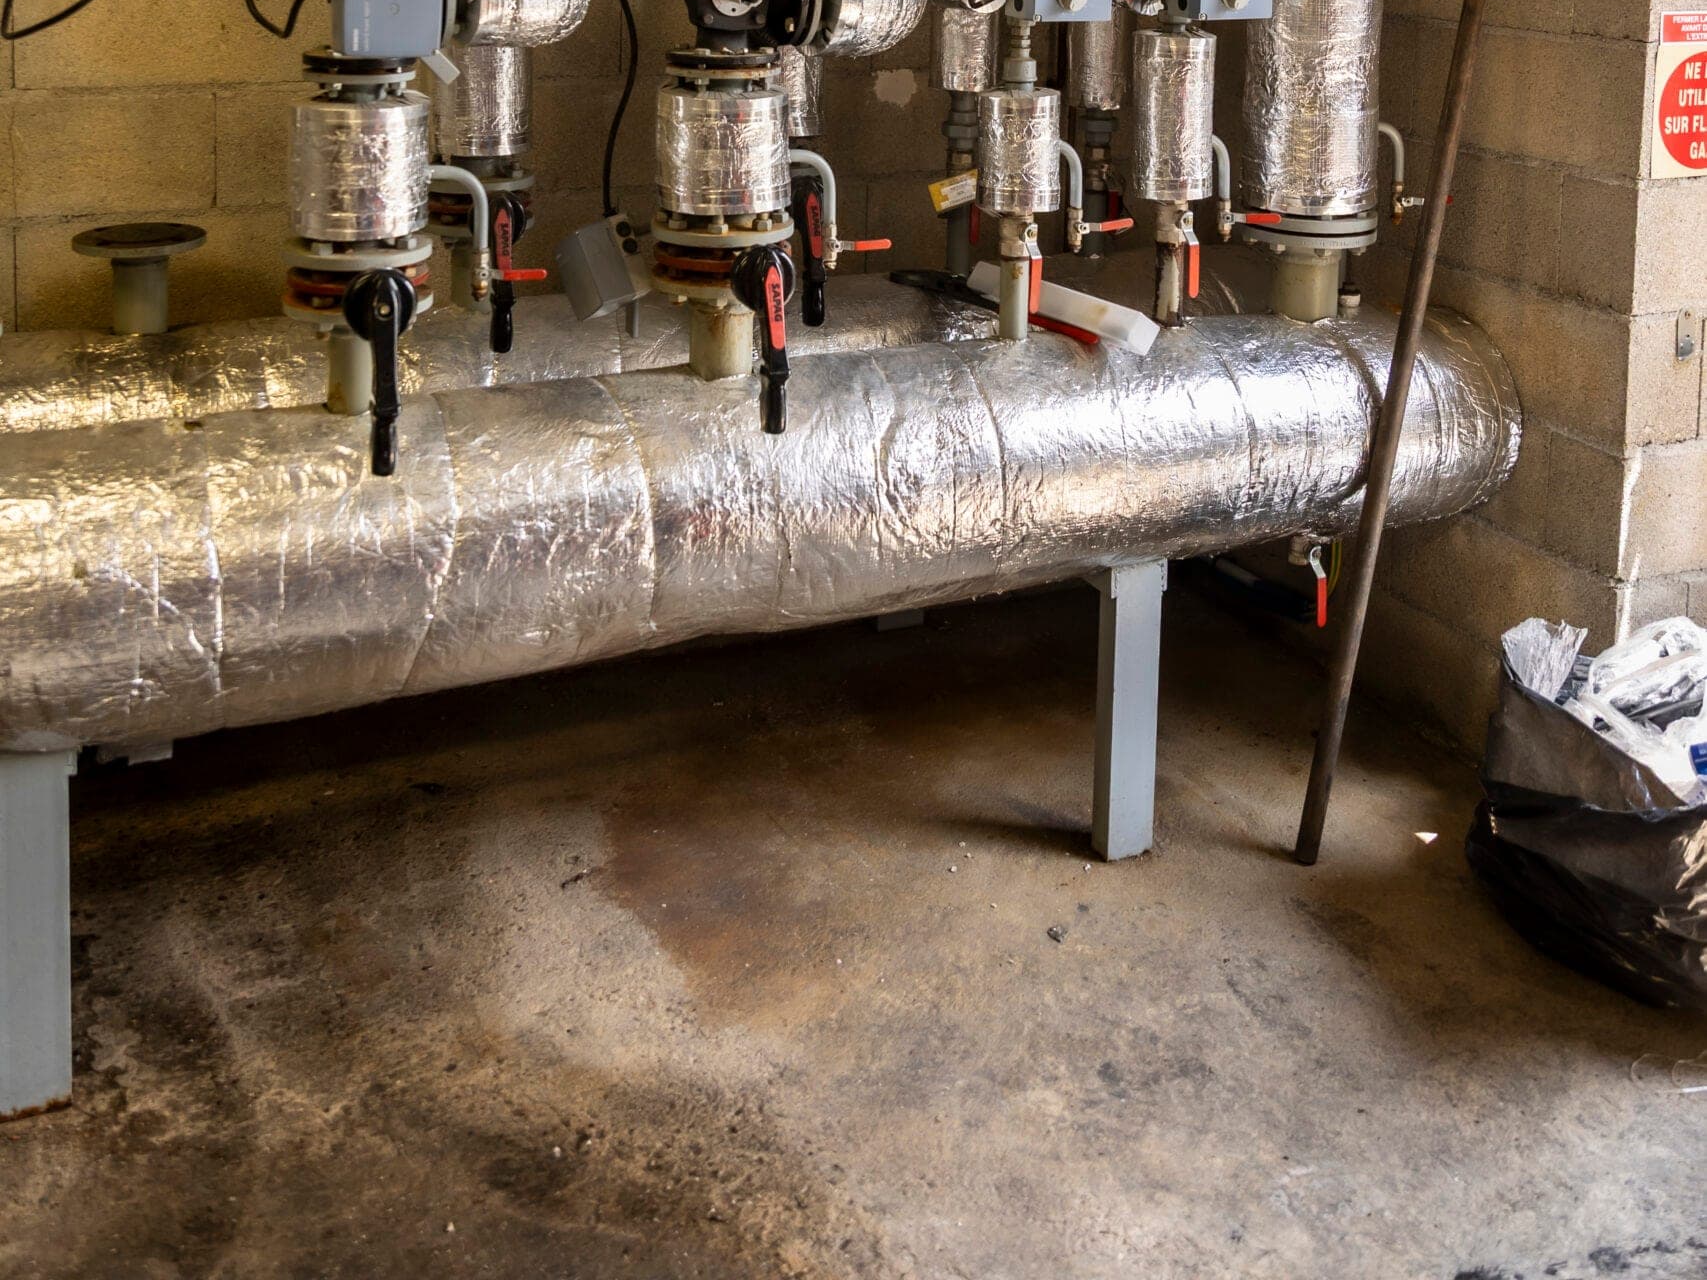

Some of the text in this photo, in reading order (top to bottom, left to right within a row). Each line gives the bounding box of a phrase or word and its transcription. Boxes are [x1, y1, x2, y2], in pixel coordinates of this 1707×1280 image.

[1684, 61, 1702, 80] NE
[1664, 115, 1689, 135] SUR
[771, 283, 783, 322] SAPAG
